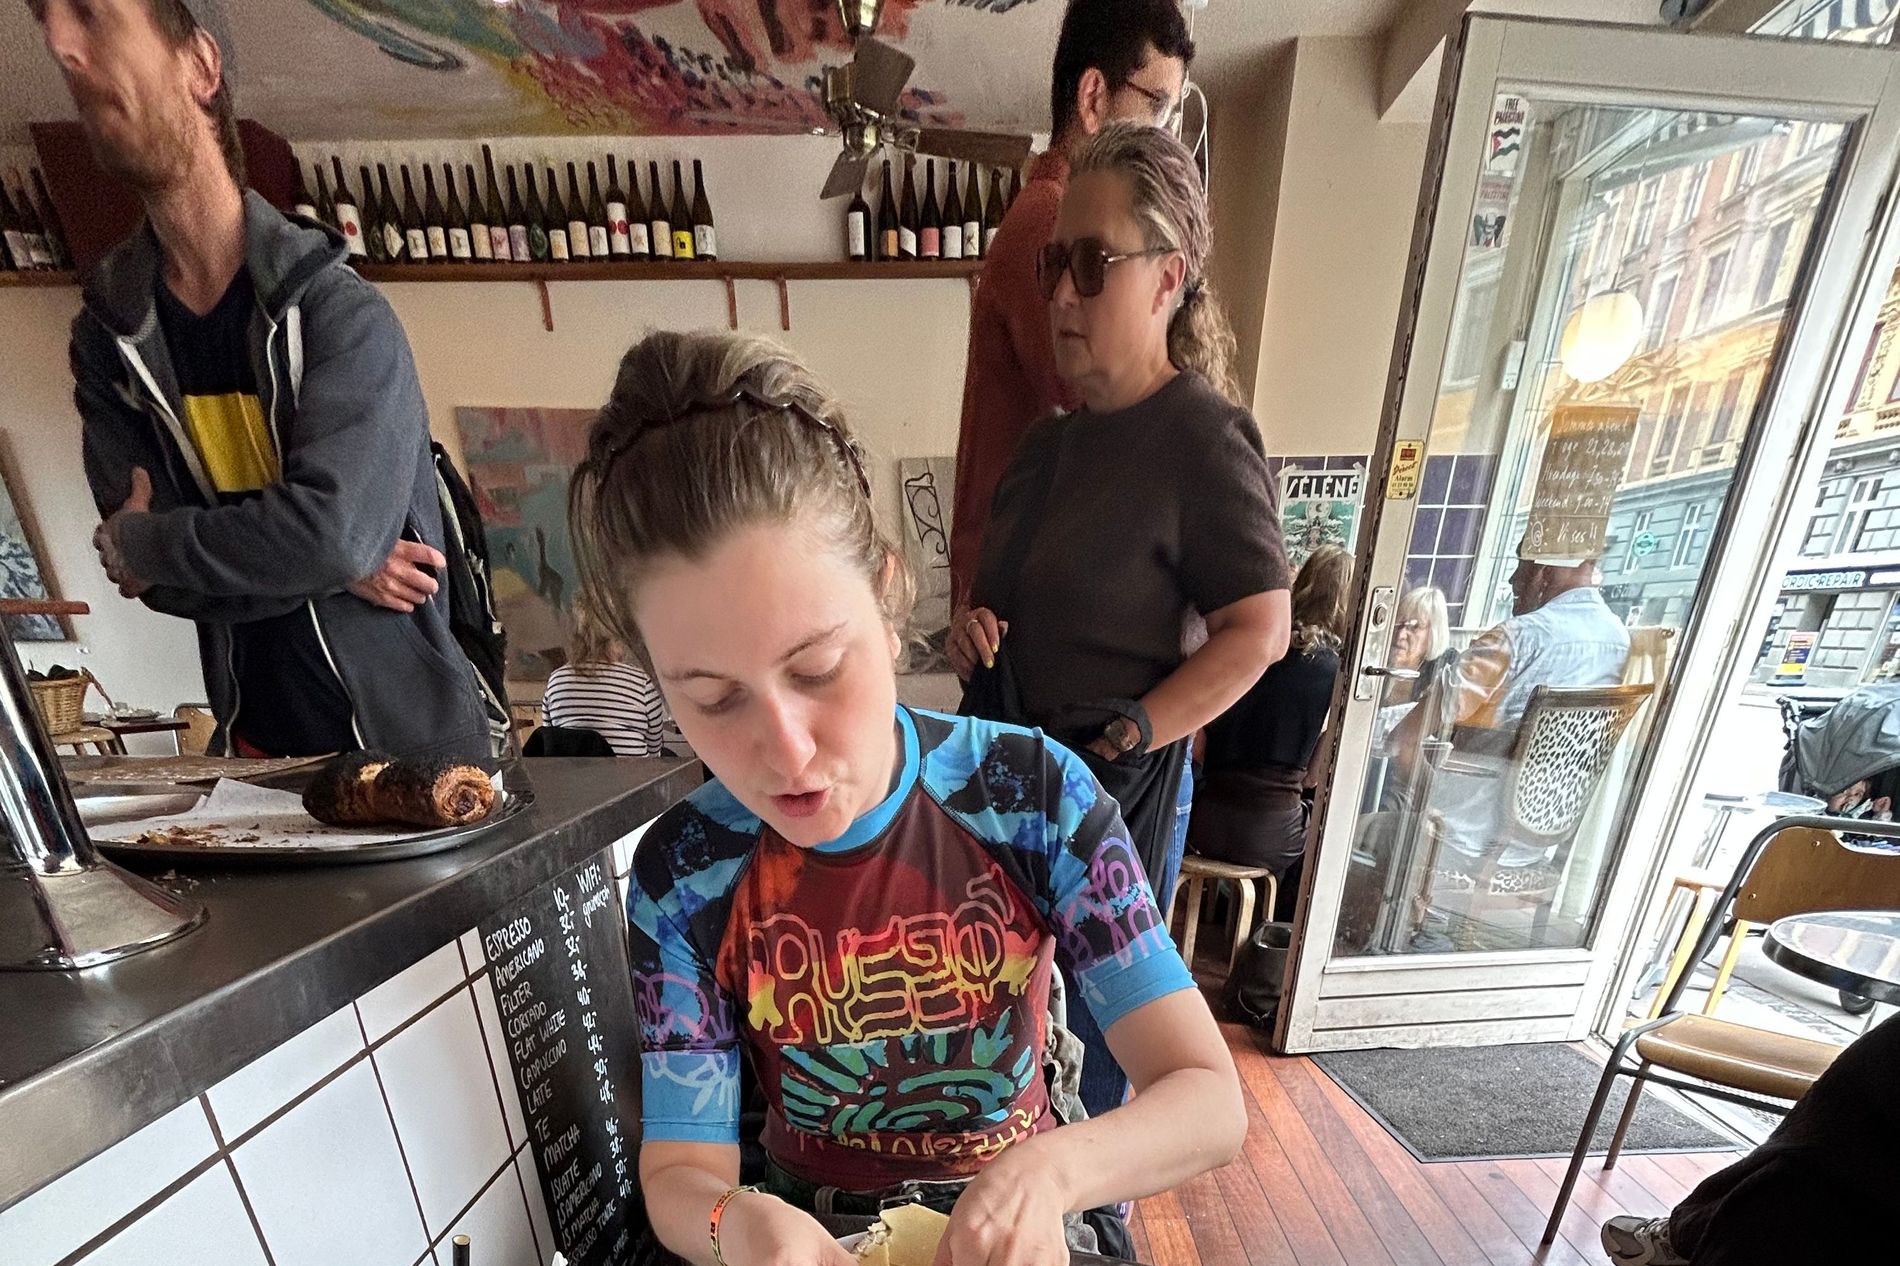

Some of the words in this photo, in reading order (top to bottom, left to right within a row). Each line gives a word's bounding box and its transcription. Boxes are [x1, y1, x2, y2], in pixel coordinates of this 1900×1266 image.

[1781, 576, 1816, 589] ORDIC
[1818, 573, 1862, 587] REPAIR
[485, 916, 532, 961] ESPRESSO
[495, 938, 545, 990] AMERICANO
[507, 1001, 547, 1039] CORTADO
[514, 1033, 537, 1064] FLAT
[539, 1008, 566, 1043] WHITE
[526, 1078, 553, 1115] LATTE
[535, 1116, 551, 1143] TE
[543, 1123, 580, 1173] MATCHA
